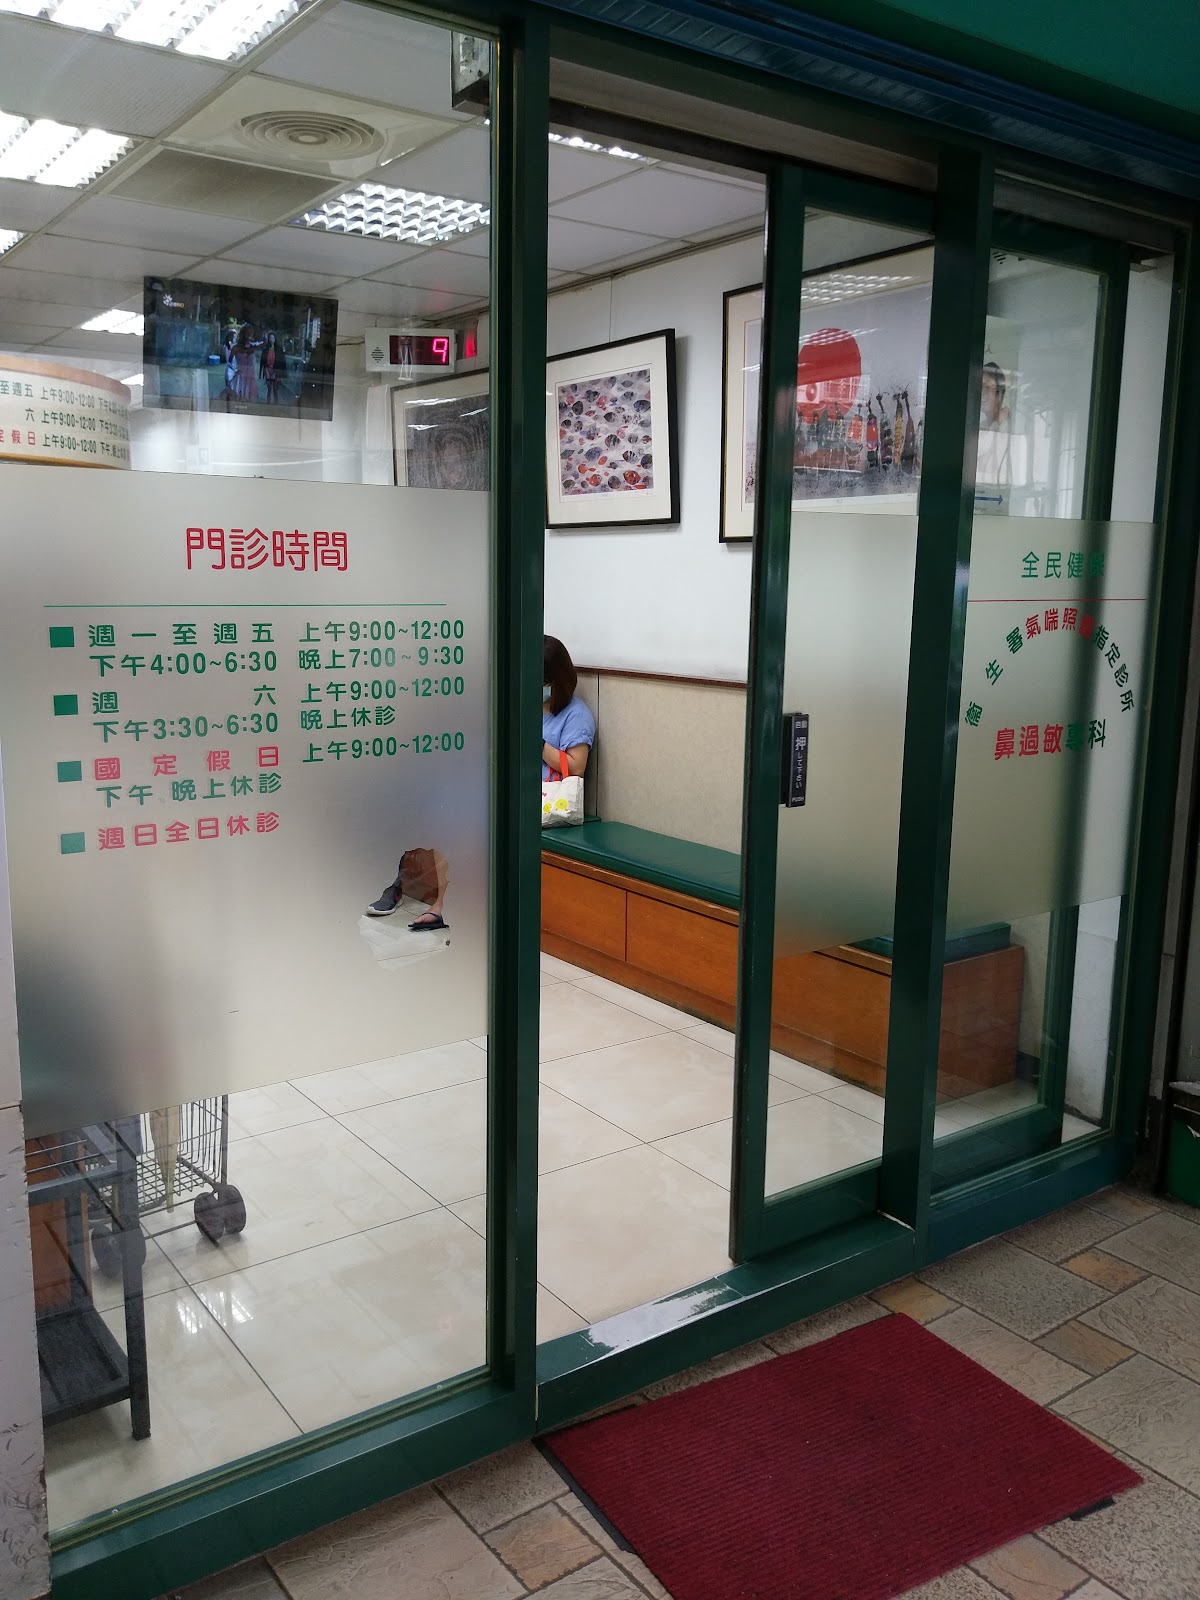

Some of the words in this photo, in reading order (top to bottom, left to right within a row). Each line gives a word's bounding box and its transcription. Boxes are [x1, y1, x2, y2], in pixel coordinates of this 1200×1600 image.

[433, 338, 448, 363] 9
[185, 527, 348, 572] 門診時間
[88, 623, 274, 647] 週一至週五
[299, 619, 464, 643] 上午9:00~12:00
[89, 650, 277, 677] 下午4:00~6:30
[301, 676, 464, 703] 上午9:00~12:00
[93, 712, 278, 743] 下午3:30~6:30
[300, 705, 396, 731] 晚上休診
[94, 746, 279, 781] 國定假日
[302, 731, 465, 763] 上午9:00~12:00
[98, 811, 280, 851] 週日全日休診
